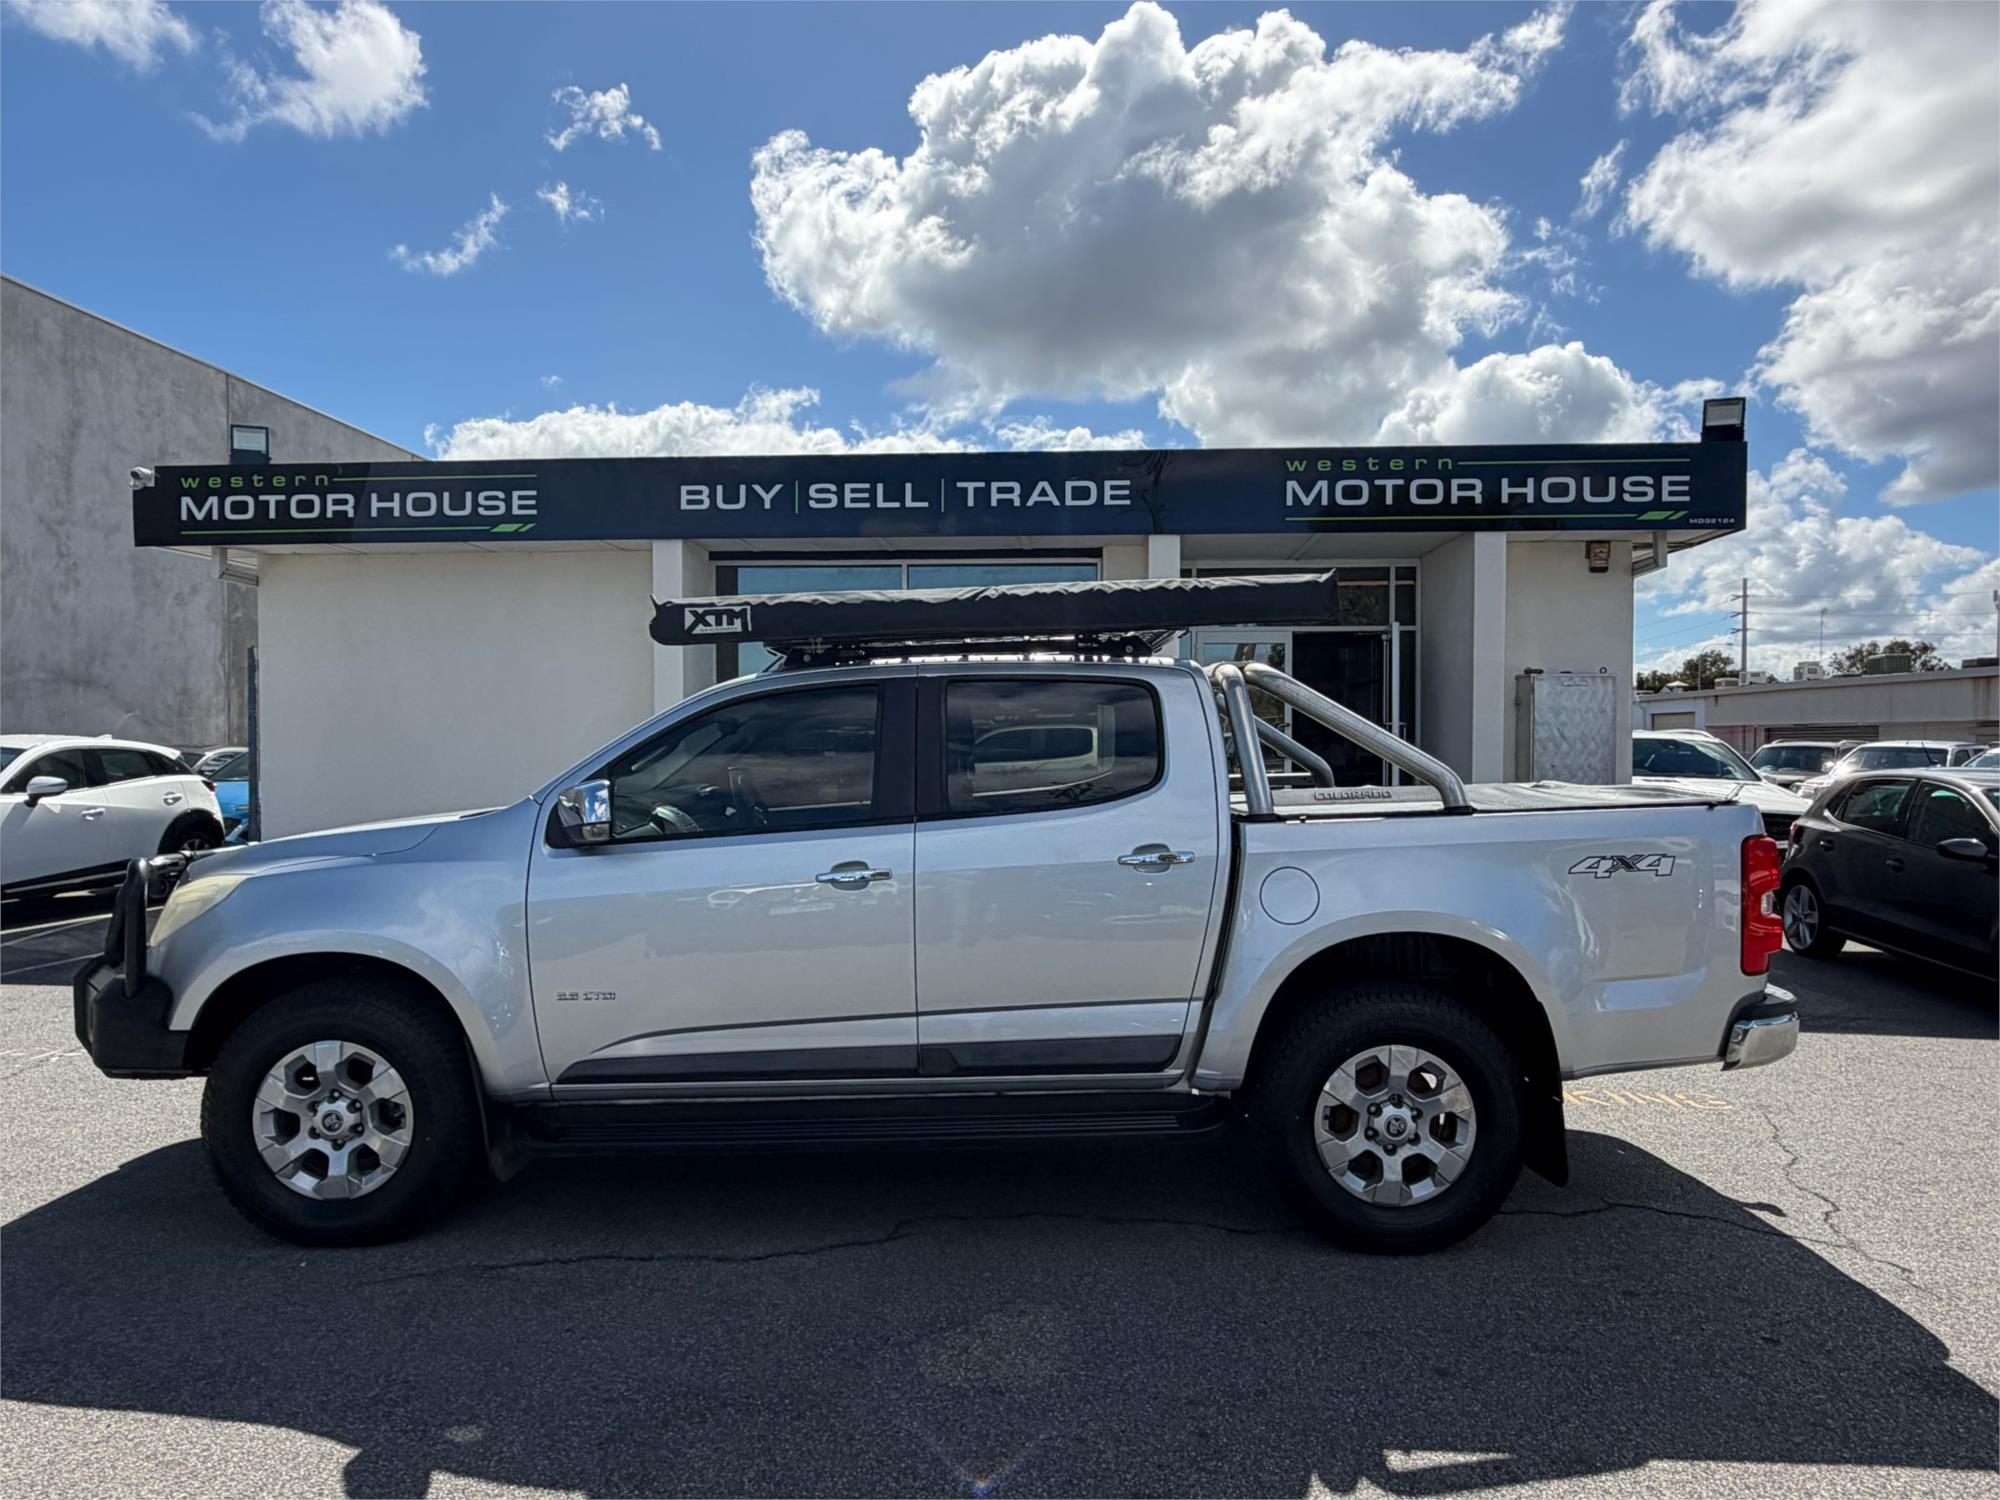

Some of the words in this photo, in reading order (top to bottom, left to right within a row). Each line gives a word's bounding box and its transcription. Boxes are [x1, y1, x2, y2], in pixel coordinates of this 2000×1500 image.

[1285, 457, 1452, 472] western
[180, 474, 329, 489] western
[679, 484, 784, 511] BUY
[807, 482, 930, 509] SELL
[956, 479, 1132, 507] TRADE
[1285, 478, 1484, 506] MOTOR
[1501, 475, 1691, 503] HOUSE
[180, 493, 355, 521] MOTOR
[370, 490, 538, 518] HOUSE
[685, 607, 750, 634] XTM
[1314, 790, 1392, 801] COLORADO
